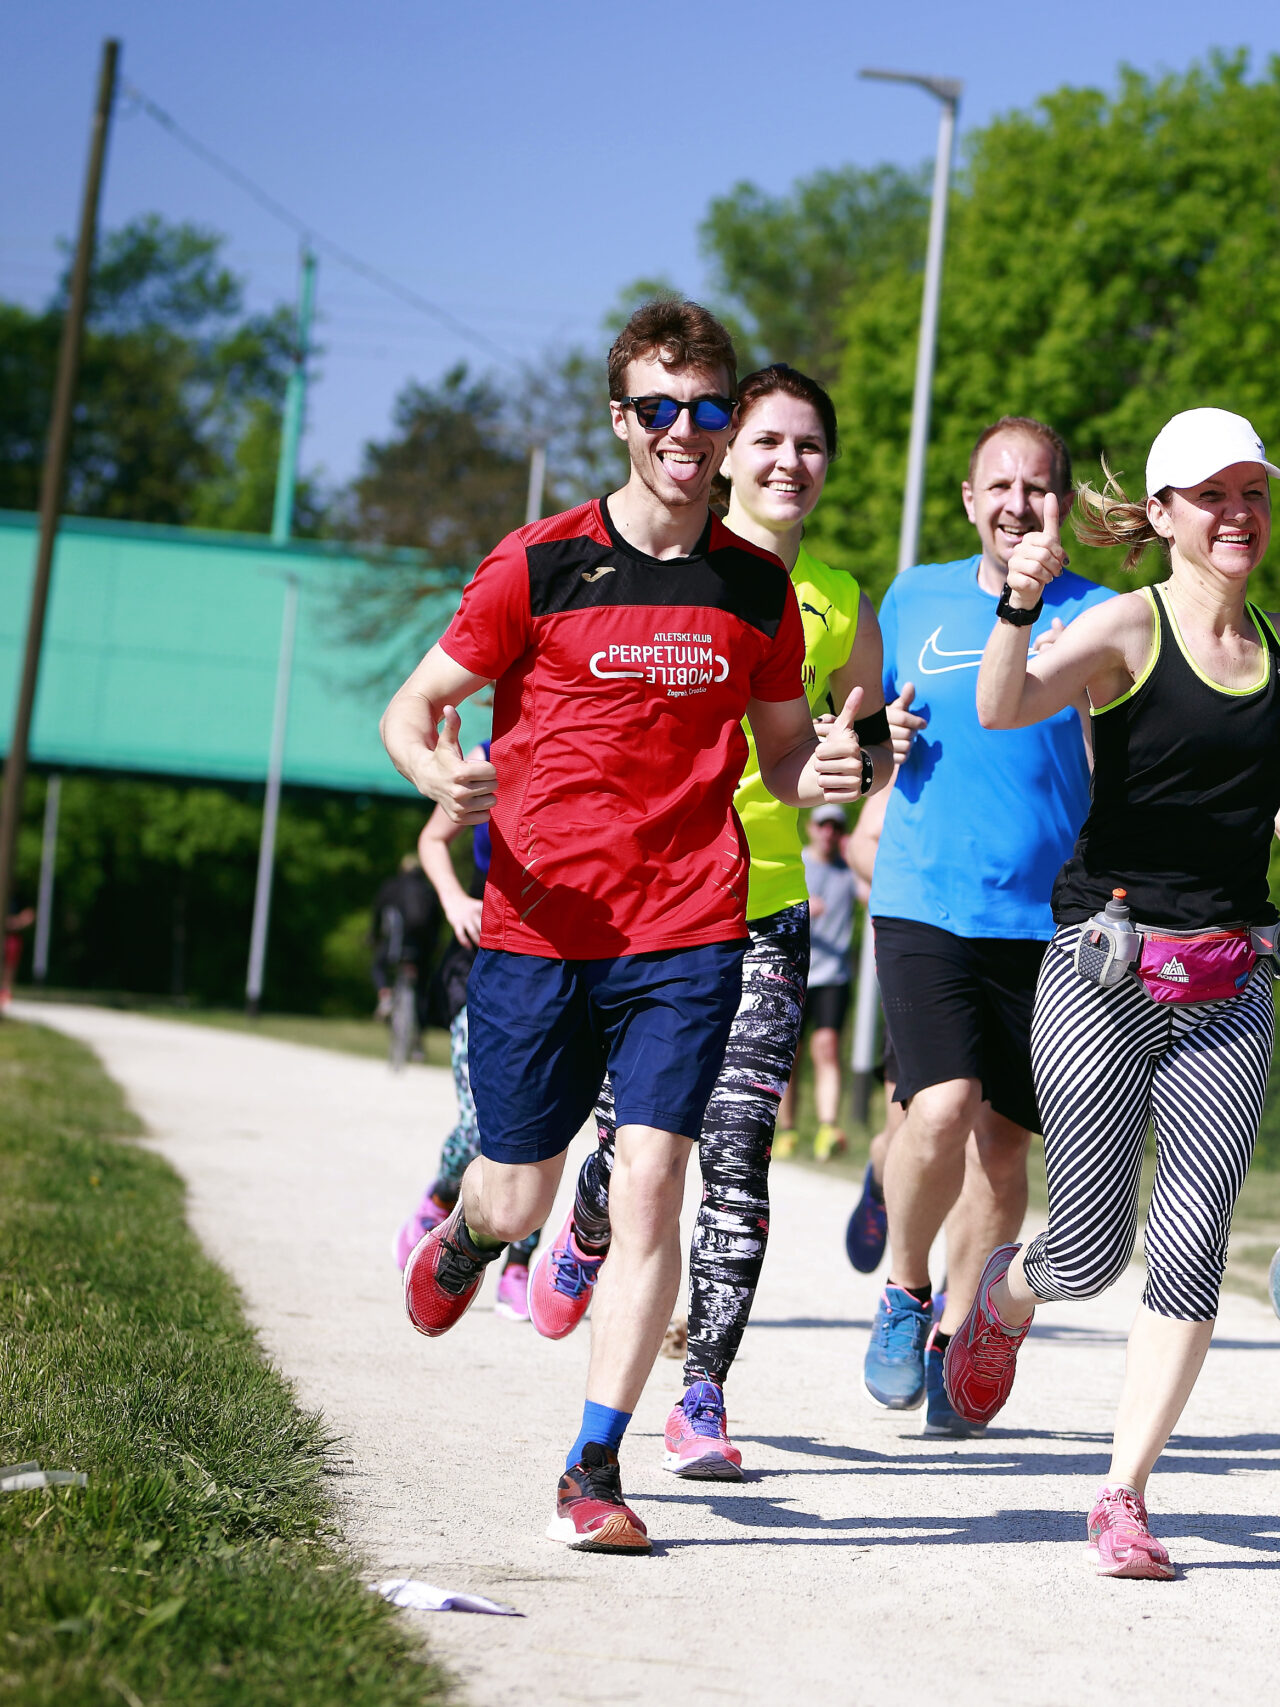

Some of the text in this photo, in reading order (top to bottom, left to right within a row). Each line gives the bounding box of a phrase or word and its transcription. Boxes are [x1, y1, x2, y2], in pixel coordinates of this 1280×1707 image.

[653, 632, 712, 643] ATLETSKI KLUB
[608, 644, 713, 666] PERPETUUM
[645, 666, 713, 686] MOBILE
